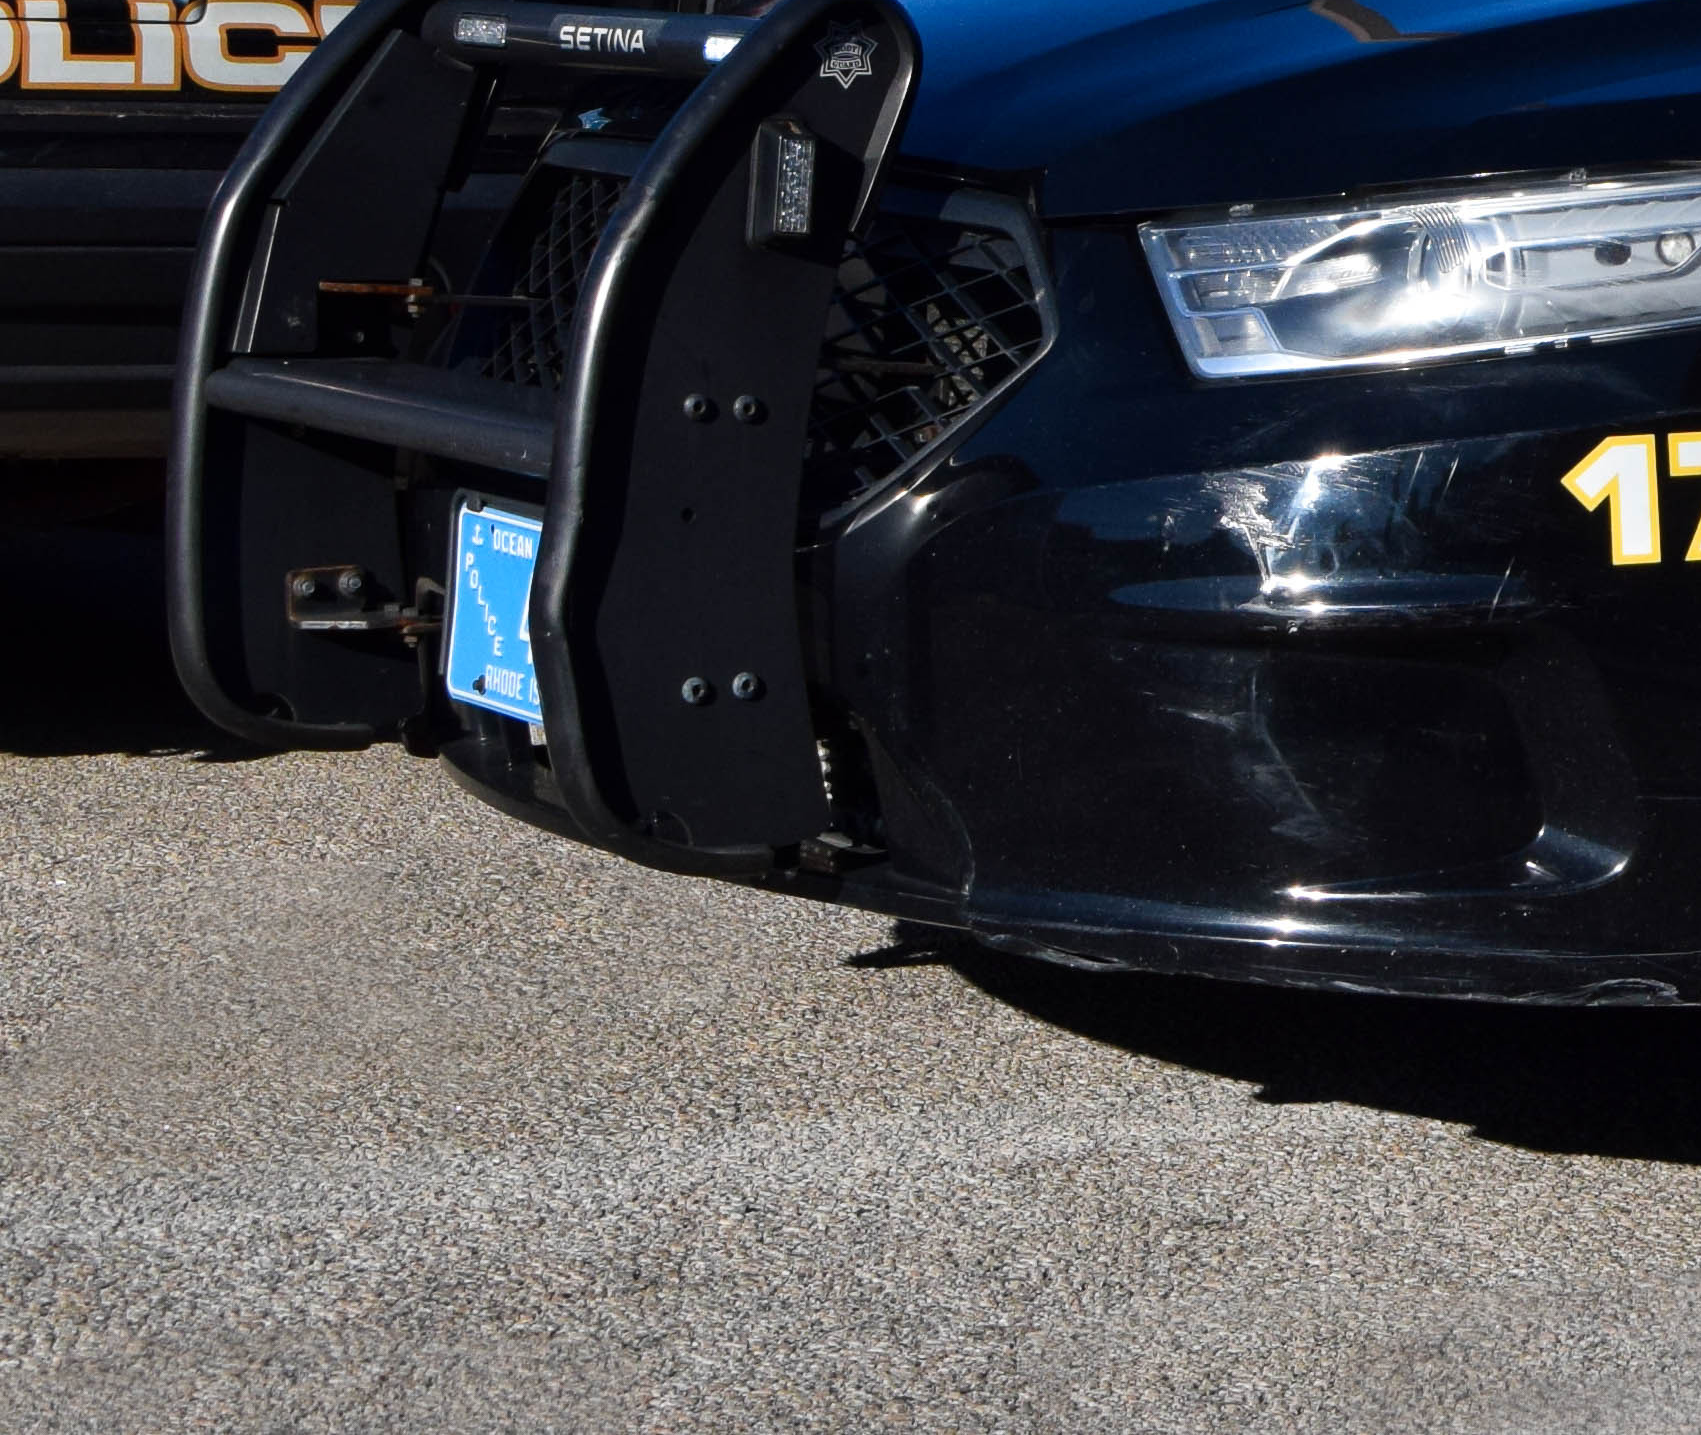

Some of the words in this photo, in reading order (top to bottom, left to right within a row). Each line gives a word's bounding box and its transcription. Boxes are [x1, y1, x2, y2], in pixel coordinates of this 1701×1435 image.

[559, 25, 646, 54] SETINA
[492, 527, 533, 560] OCEAN
[464, 552, 503, 657] POLICE
[484, 664, 525, 701] RHODE
